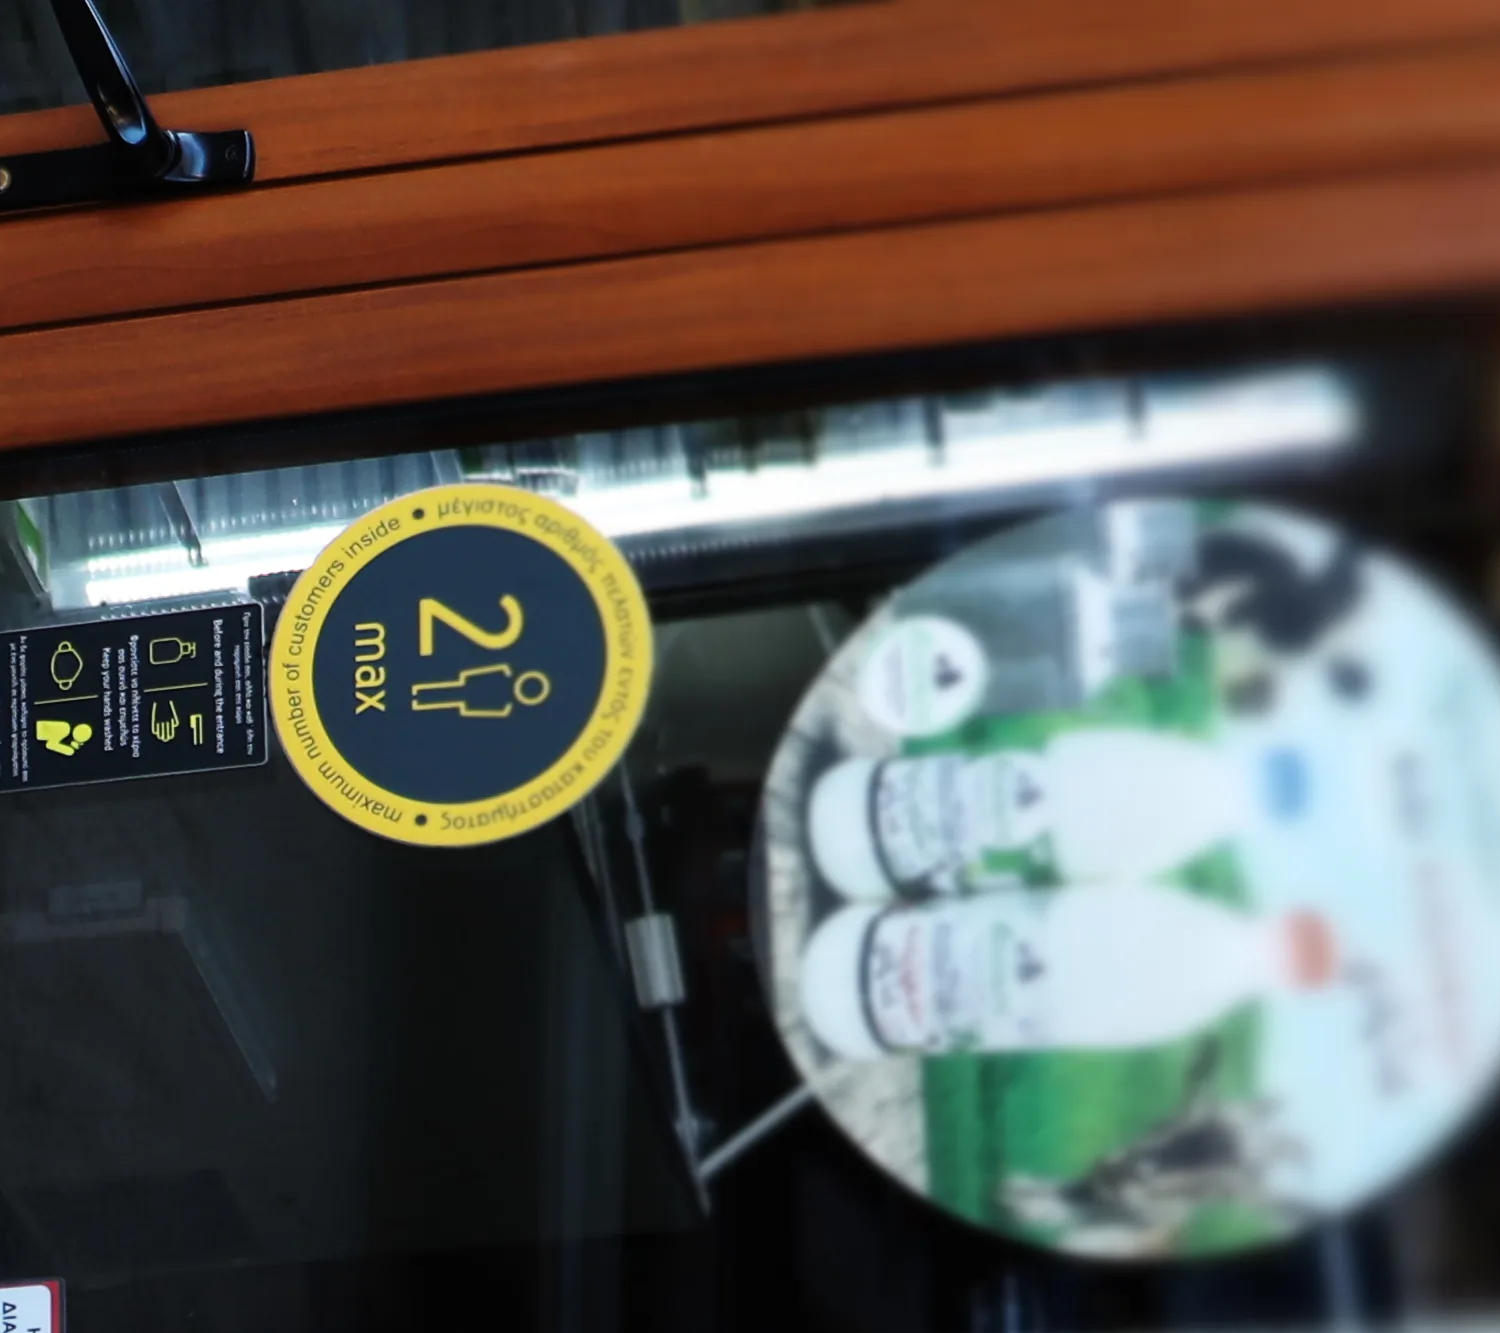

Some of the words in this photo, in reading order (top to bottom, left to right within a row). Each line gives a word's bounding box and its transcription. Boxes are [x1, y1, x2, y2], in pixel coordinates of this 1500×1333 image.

[436, 496, 530, 525] μέγιστος
[341, 518, 401, 561] inside
[532, 514, 604, 574] αριθμός
[287, 559, 345, 657] customers
[419, 594, 524, 656] 2
[600, 572, 635, 660] πελατών
[213, 619, 223, 648] Before
[101, 647, 111, 669] Keep
[214, 651, 223, 666] and
[281, 662, 303, 682] of
[354, 622, 387, 715] max
[101, 670, 110, 689] your
[212, 669, 224, 697] during
[601, 666, 635, 726] εντός
[103, 691, 113, 717] hands
[215, 698, 224, 713] the
[104, 718, 113, 751] washed
[215, 715, 224, 754] entrance
[286, 688, 323, 761] number
[582, 727, 614, 762] του
[316, 762, 403, 824] maximum
[439, 761, 585, 831] καταστήματος
